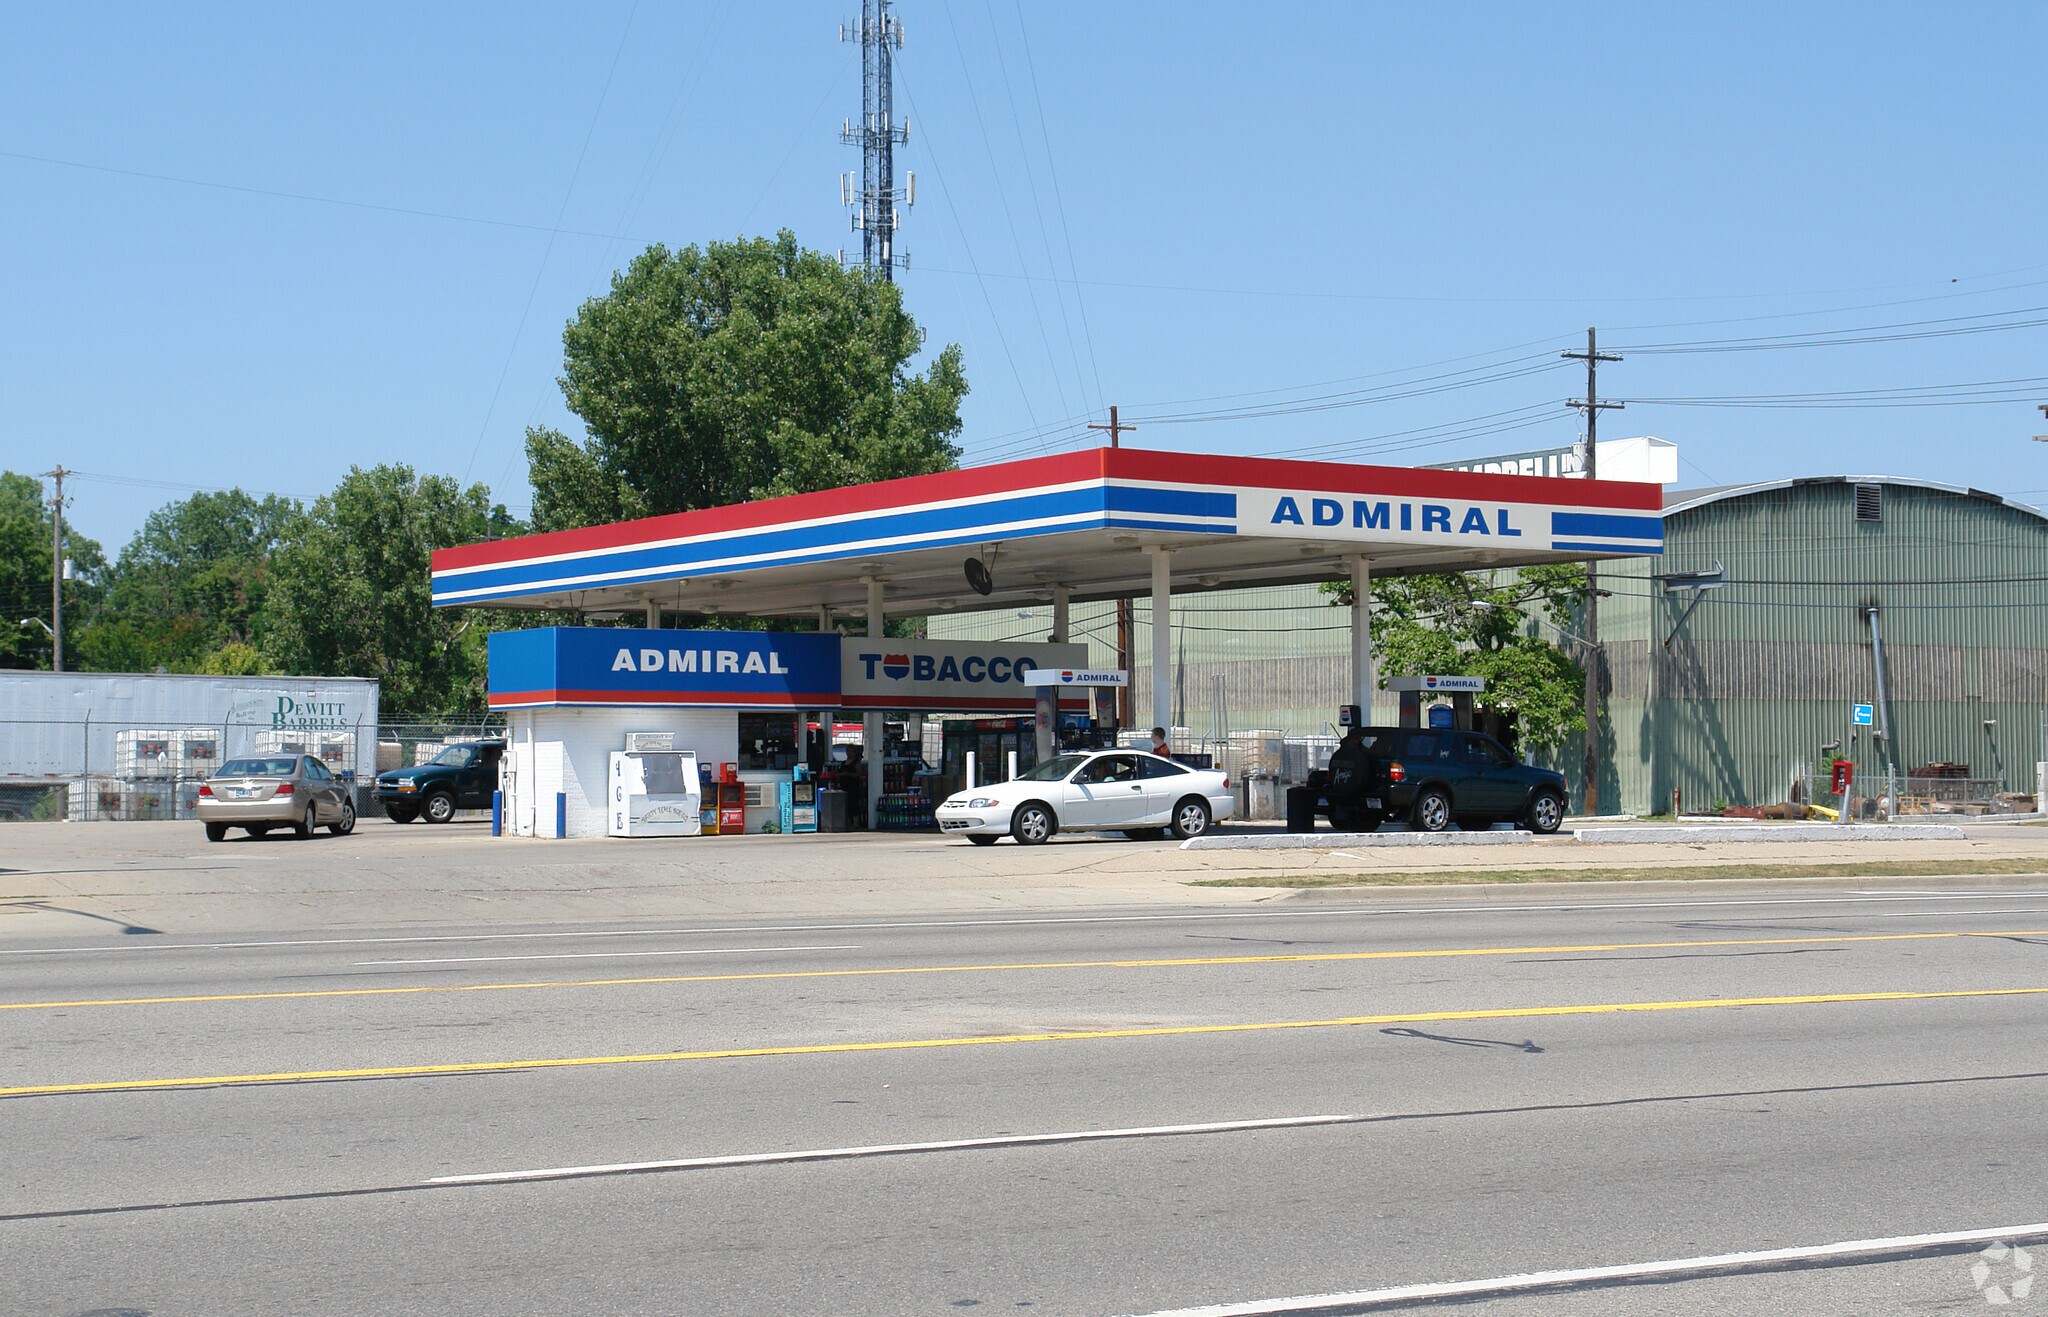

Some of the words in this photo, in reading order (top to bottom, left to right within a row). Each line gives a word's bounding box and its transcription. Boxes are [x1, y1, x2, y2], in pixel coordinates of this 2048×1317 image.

[1271, 496, 1522, 537] ADMIRAL
[611, 648, 789, 674] ADMIRAL
[1076, 674, 1121, 682] ADMIRAL
[1439, 680, 1479, 688] ADMIRAL
[270, 711, 348, 731] BARRELS
